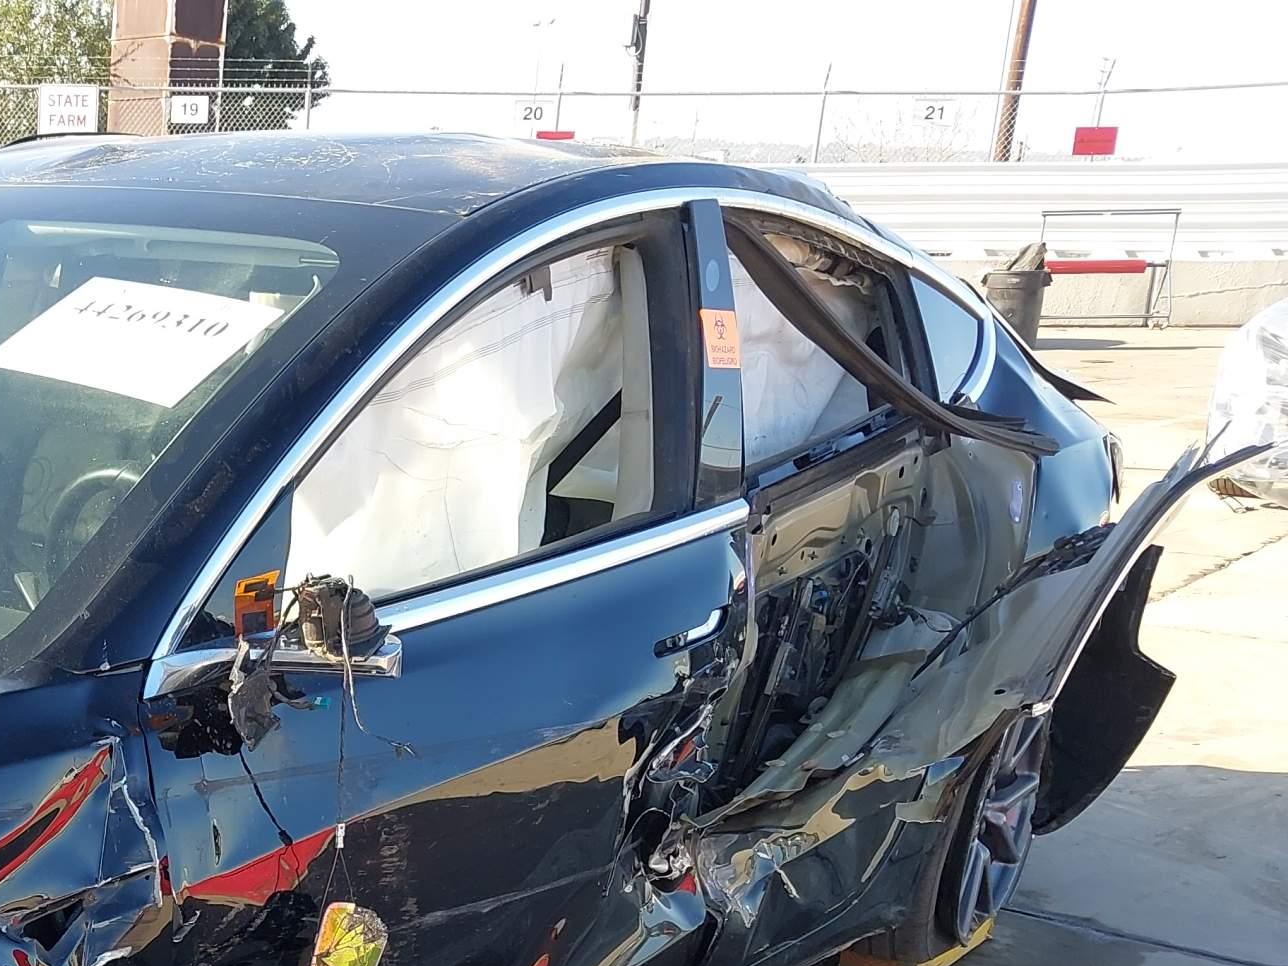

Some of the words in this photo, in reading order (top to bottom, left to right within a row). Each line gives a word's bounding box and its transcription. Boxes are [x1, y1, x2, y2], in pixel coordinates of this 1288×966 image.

[48, 94, 89, 108] STATE
[181, 102, 199, 117] 19
[522, 105, 544, 121] 20
[924, 104, 946, 121] 21
[48, 114, 87, 128] FARM
[74, 299, 230, 337] 44269310
